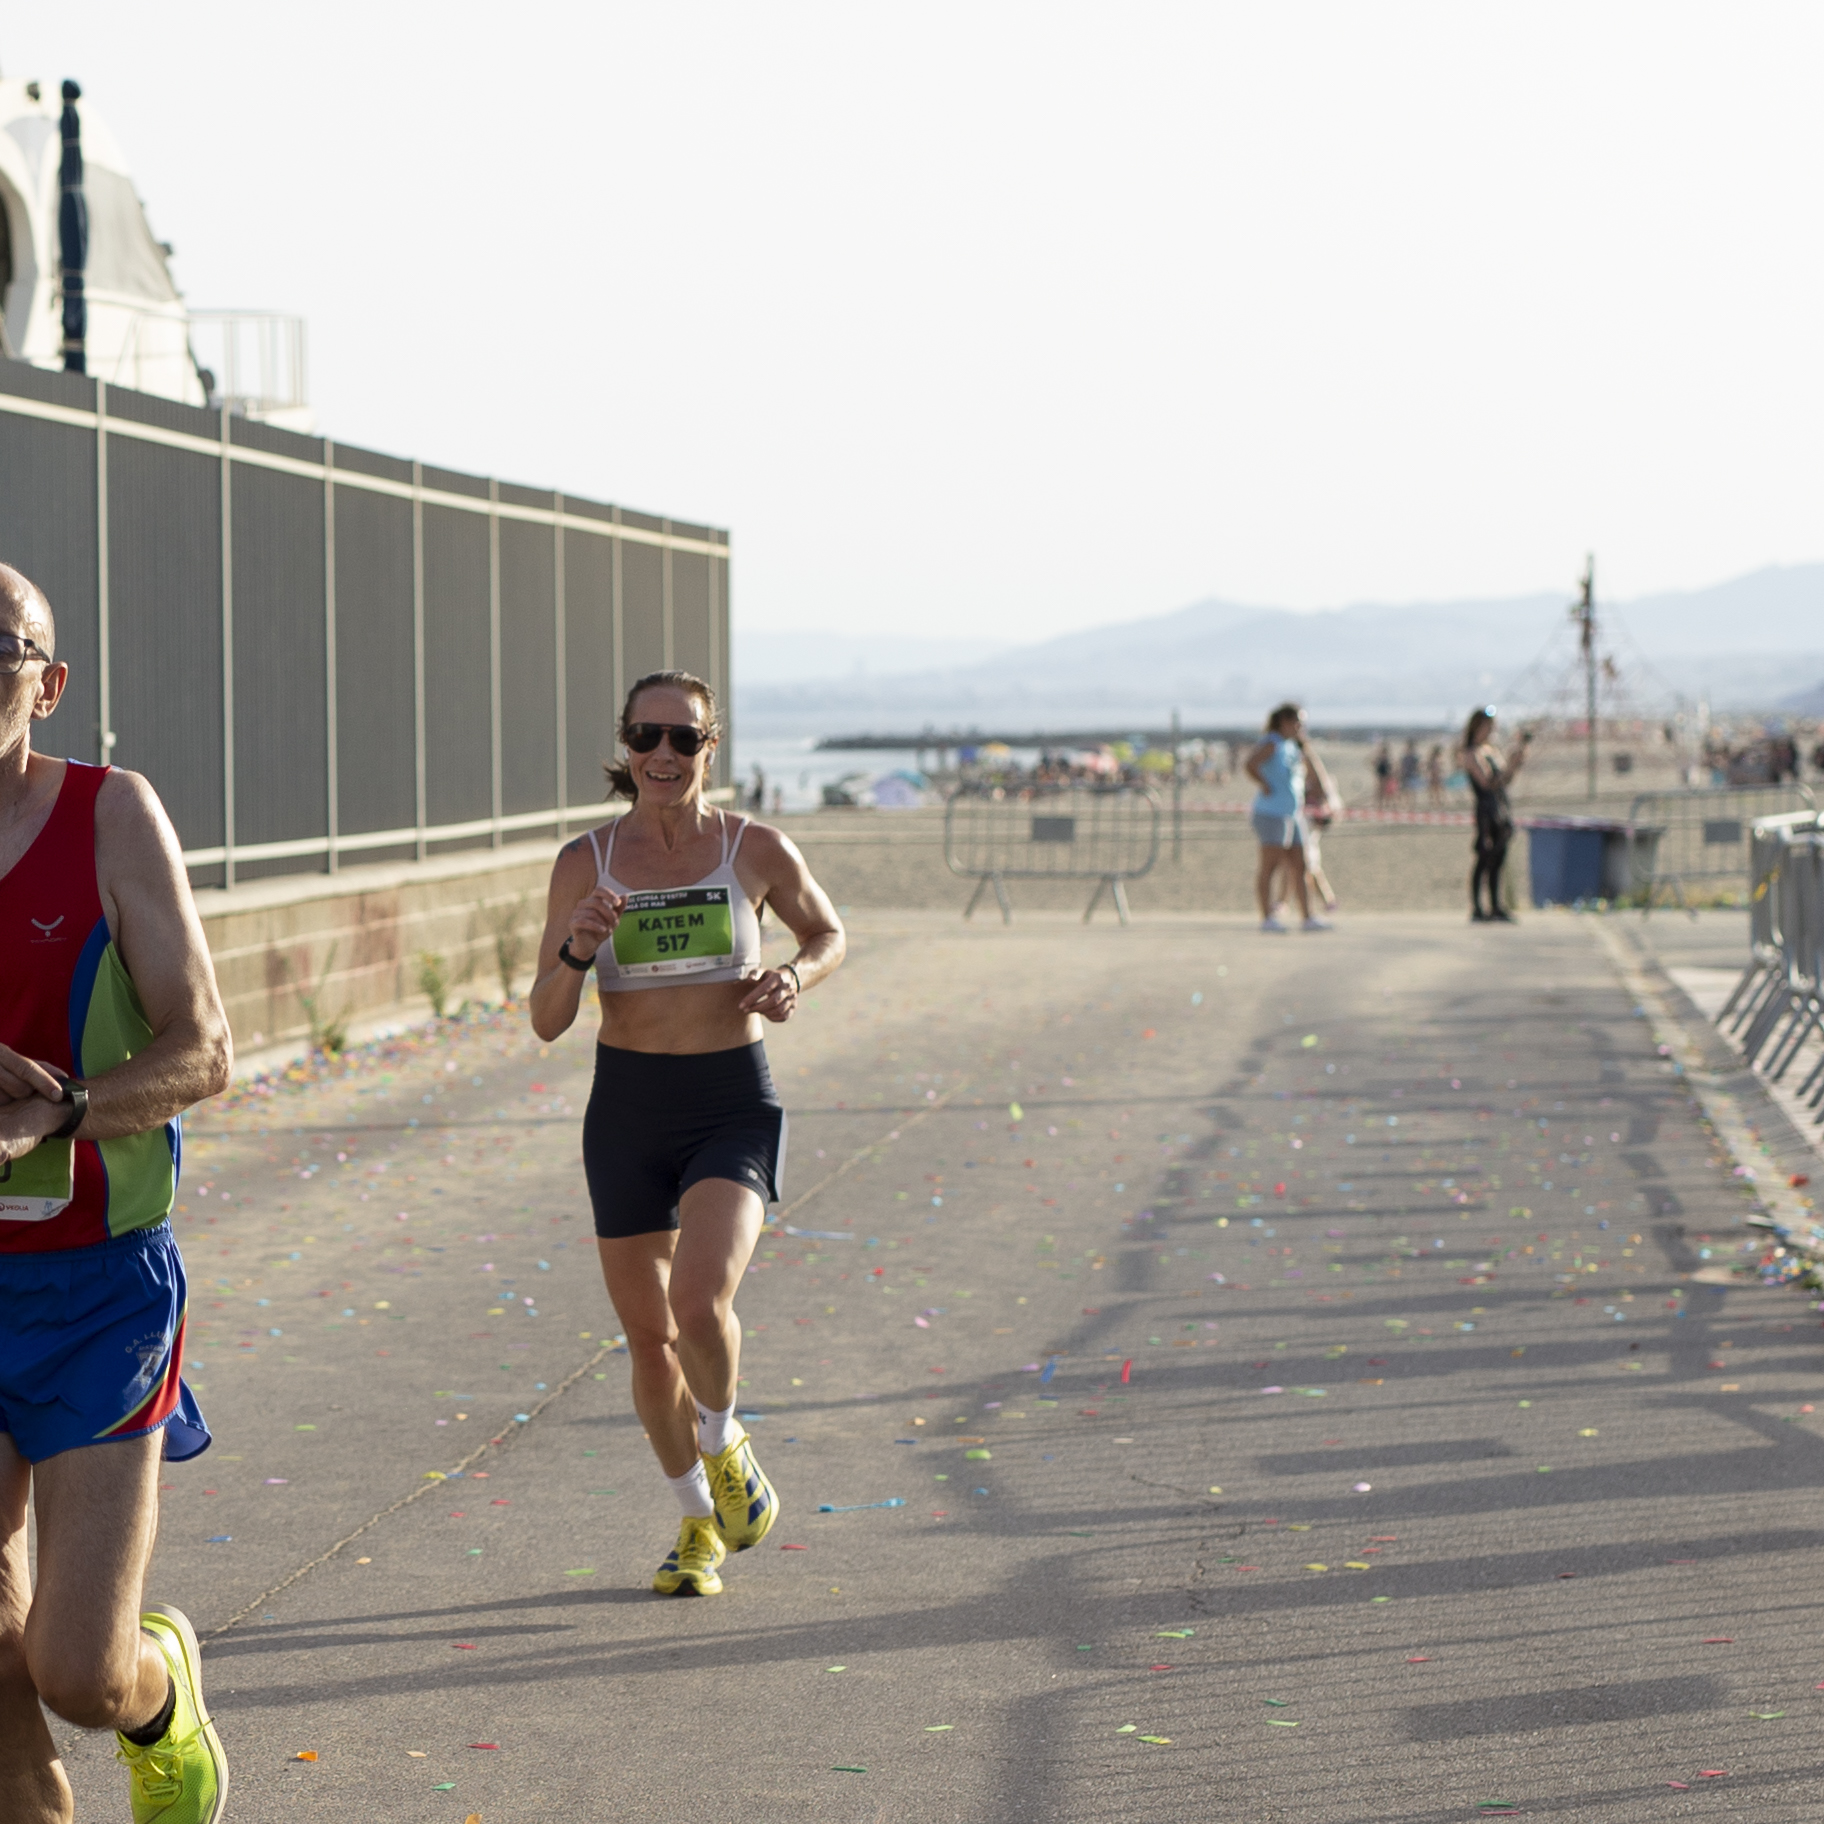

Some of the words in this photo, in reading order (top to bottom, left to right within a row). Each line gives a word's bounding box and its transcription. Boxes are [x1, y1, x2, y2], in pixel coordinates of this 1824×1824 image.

[706, 891, 722, 901] 5K
[638, 914, 685, 932] KATE
[688, 912, 705, 927] M
[656, 933, 690, 953] 517
